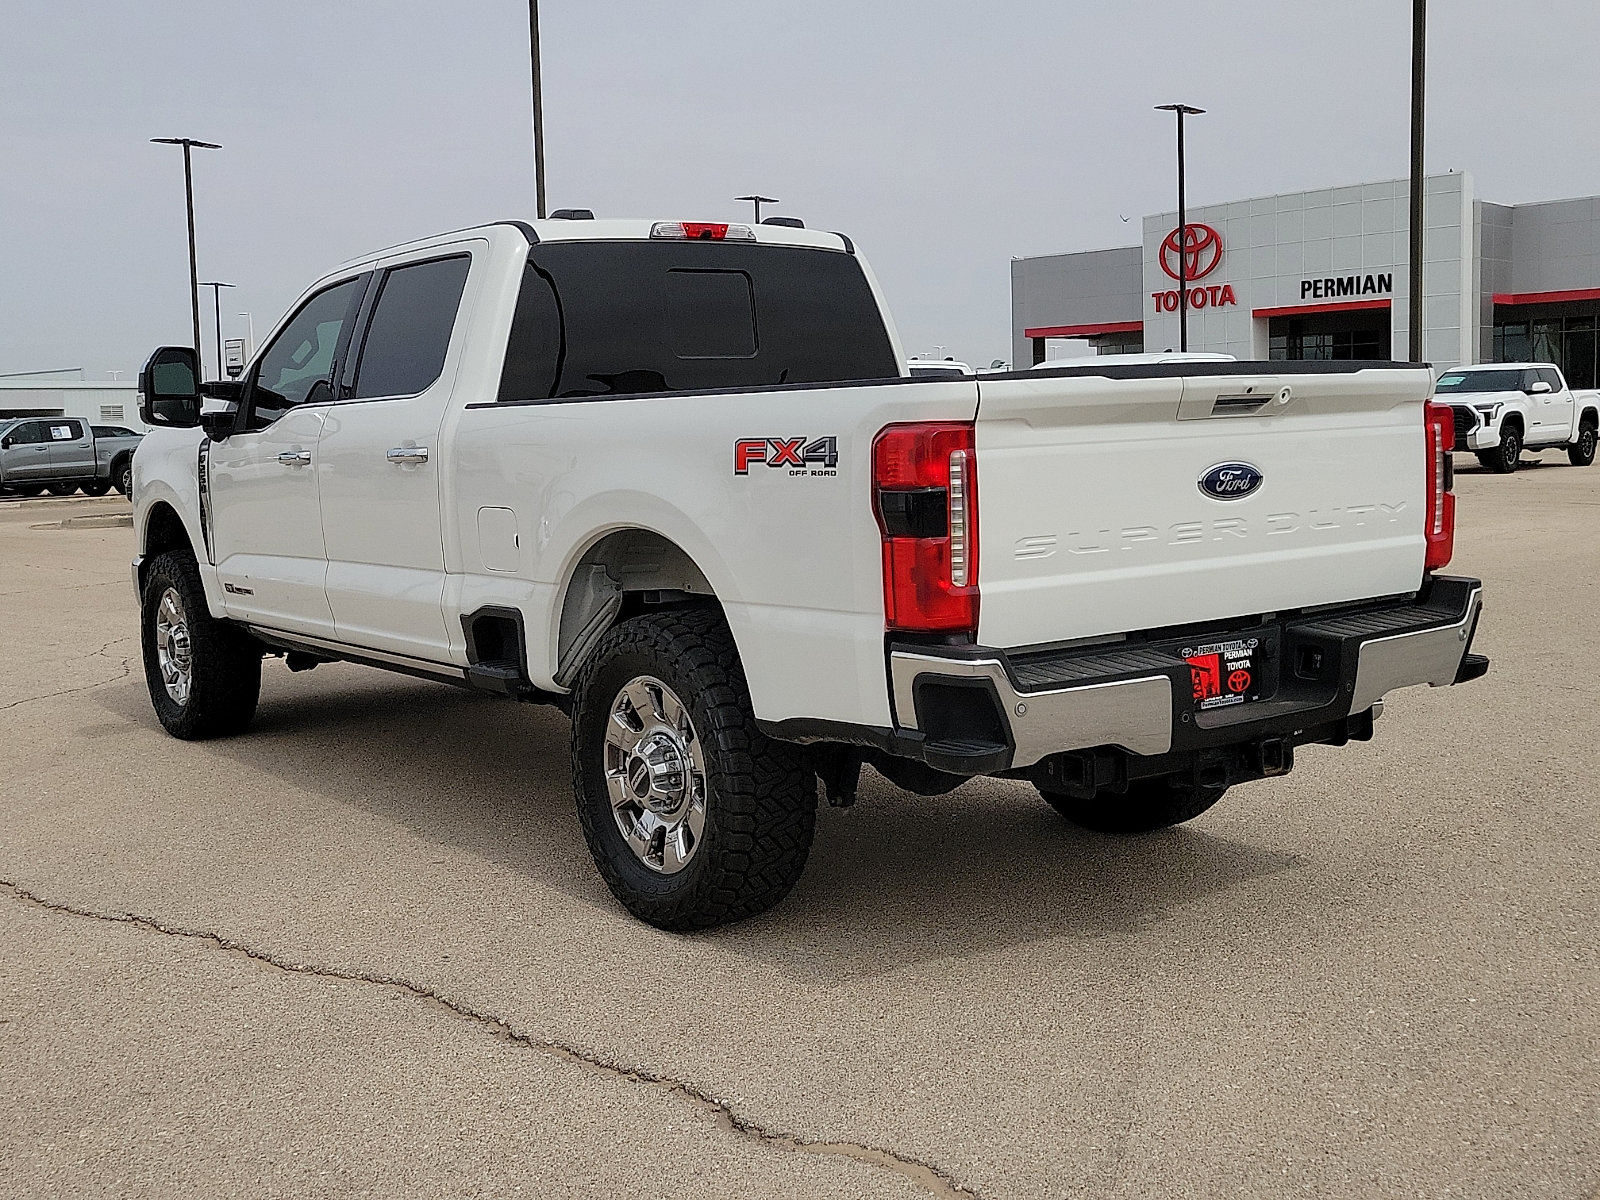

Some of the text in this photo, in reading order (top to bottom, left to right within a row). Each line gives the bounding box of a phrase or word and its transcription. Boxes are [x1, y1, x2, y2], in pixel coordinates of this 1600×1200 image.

[1151, 284, 1237, 313] TOYOTA
[1300, 273, 1392, 300] PERMIAN
[734, 436, 839, 476] FX4
[1216, 469, 1251, 492] Ford
[1014, 500, 1407, 561] SUPER DUTY
[1222, 640, 1242, 651] TOYOTA
[1224, 649, 1252, 660] PERMIAN
[1226, 660, 1251, 671] TOYOTA
